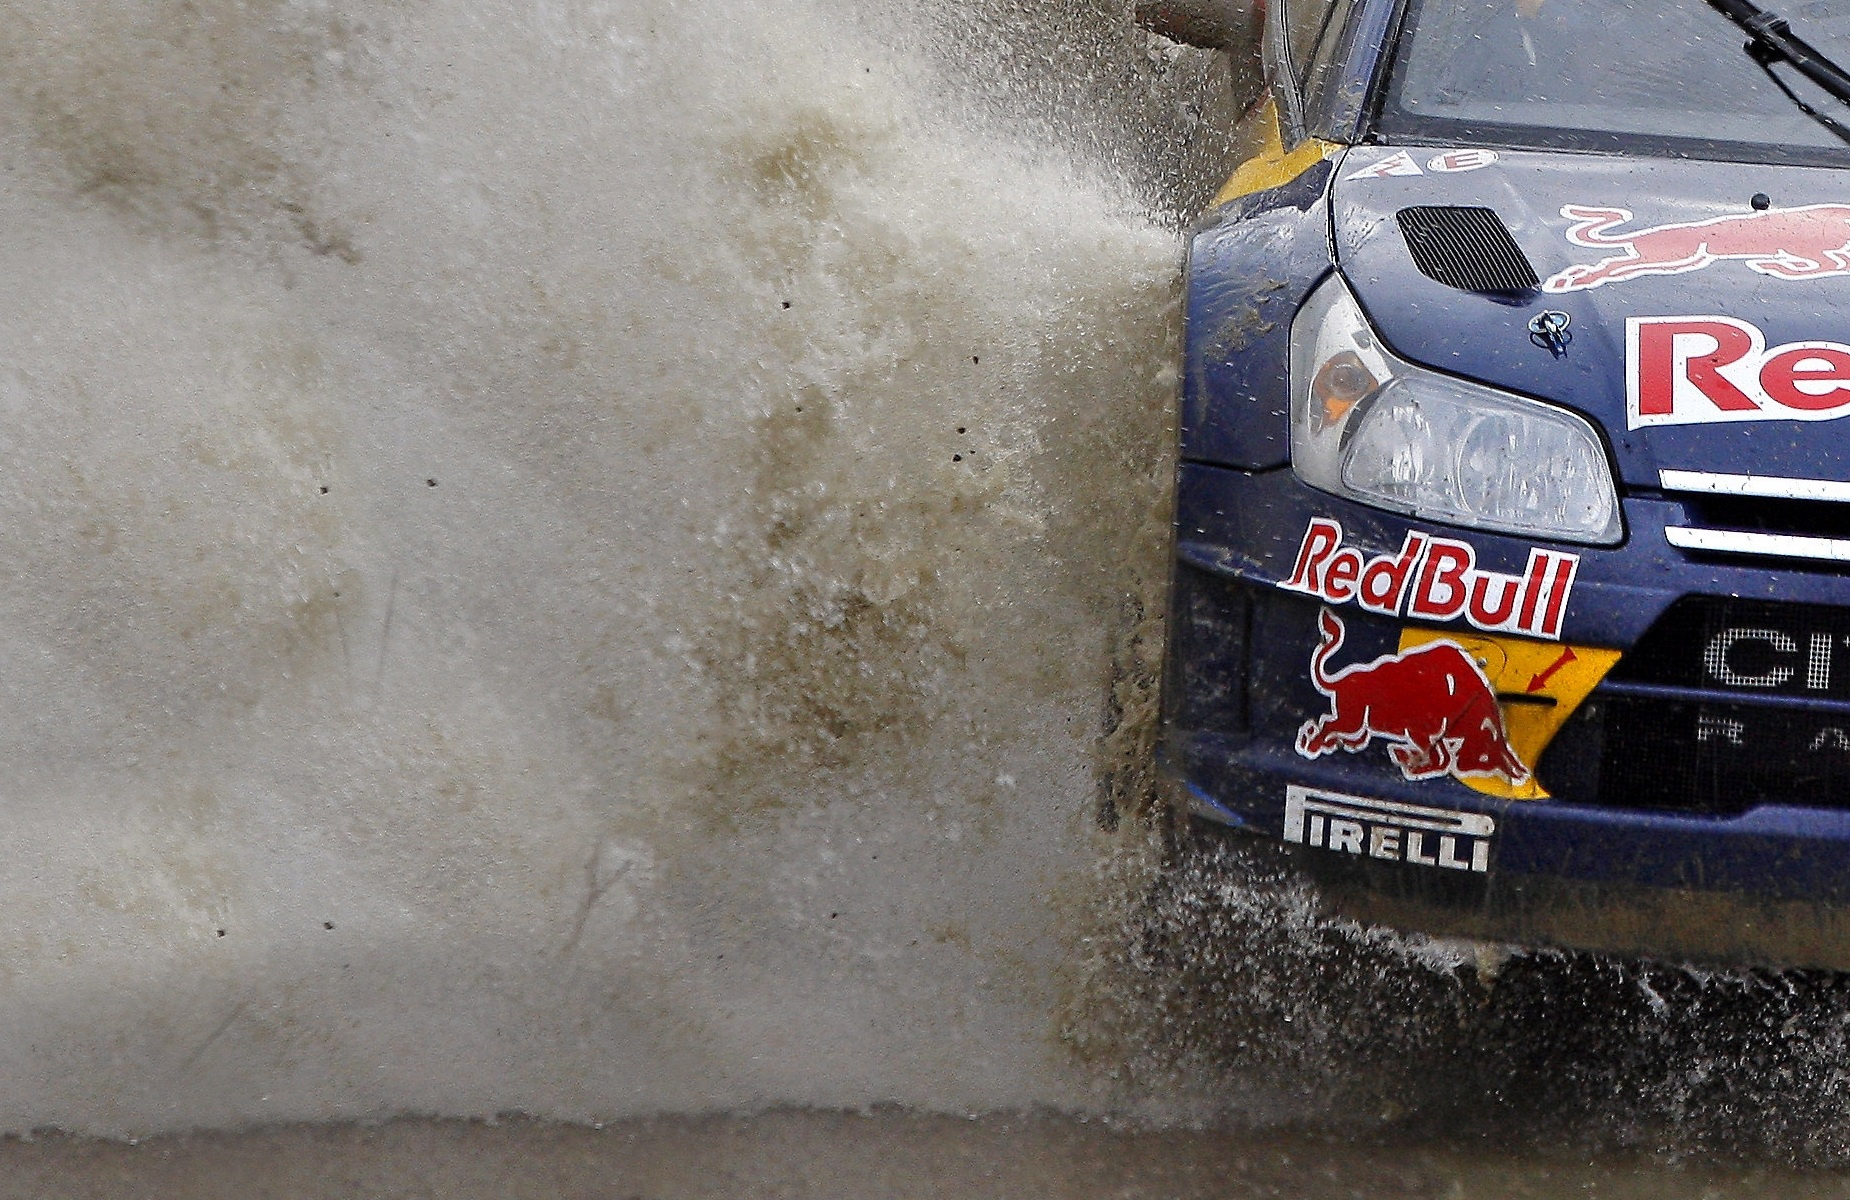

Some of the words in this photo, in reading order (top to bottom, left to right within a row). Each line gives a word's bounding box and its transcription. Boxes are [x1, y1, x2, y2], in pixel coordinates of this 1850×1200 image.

[1283, 519, 1425, 613] Red
[1410, 538, 1577, 638] Bull
[1283, 784, 1496, 873] PIRELLI
